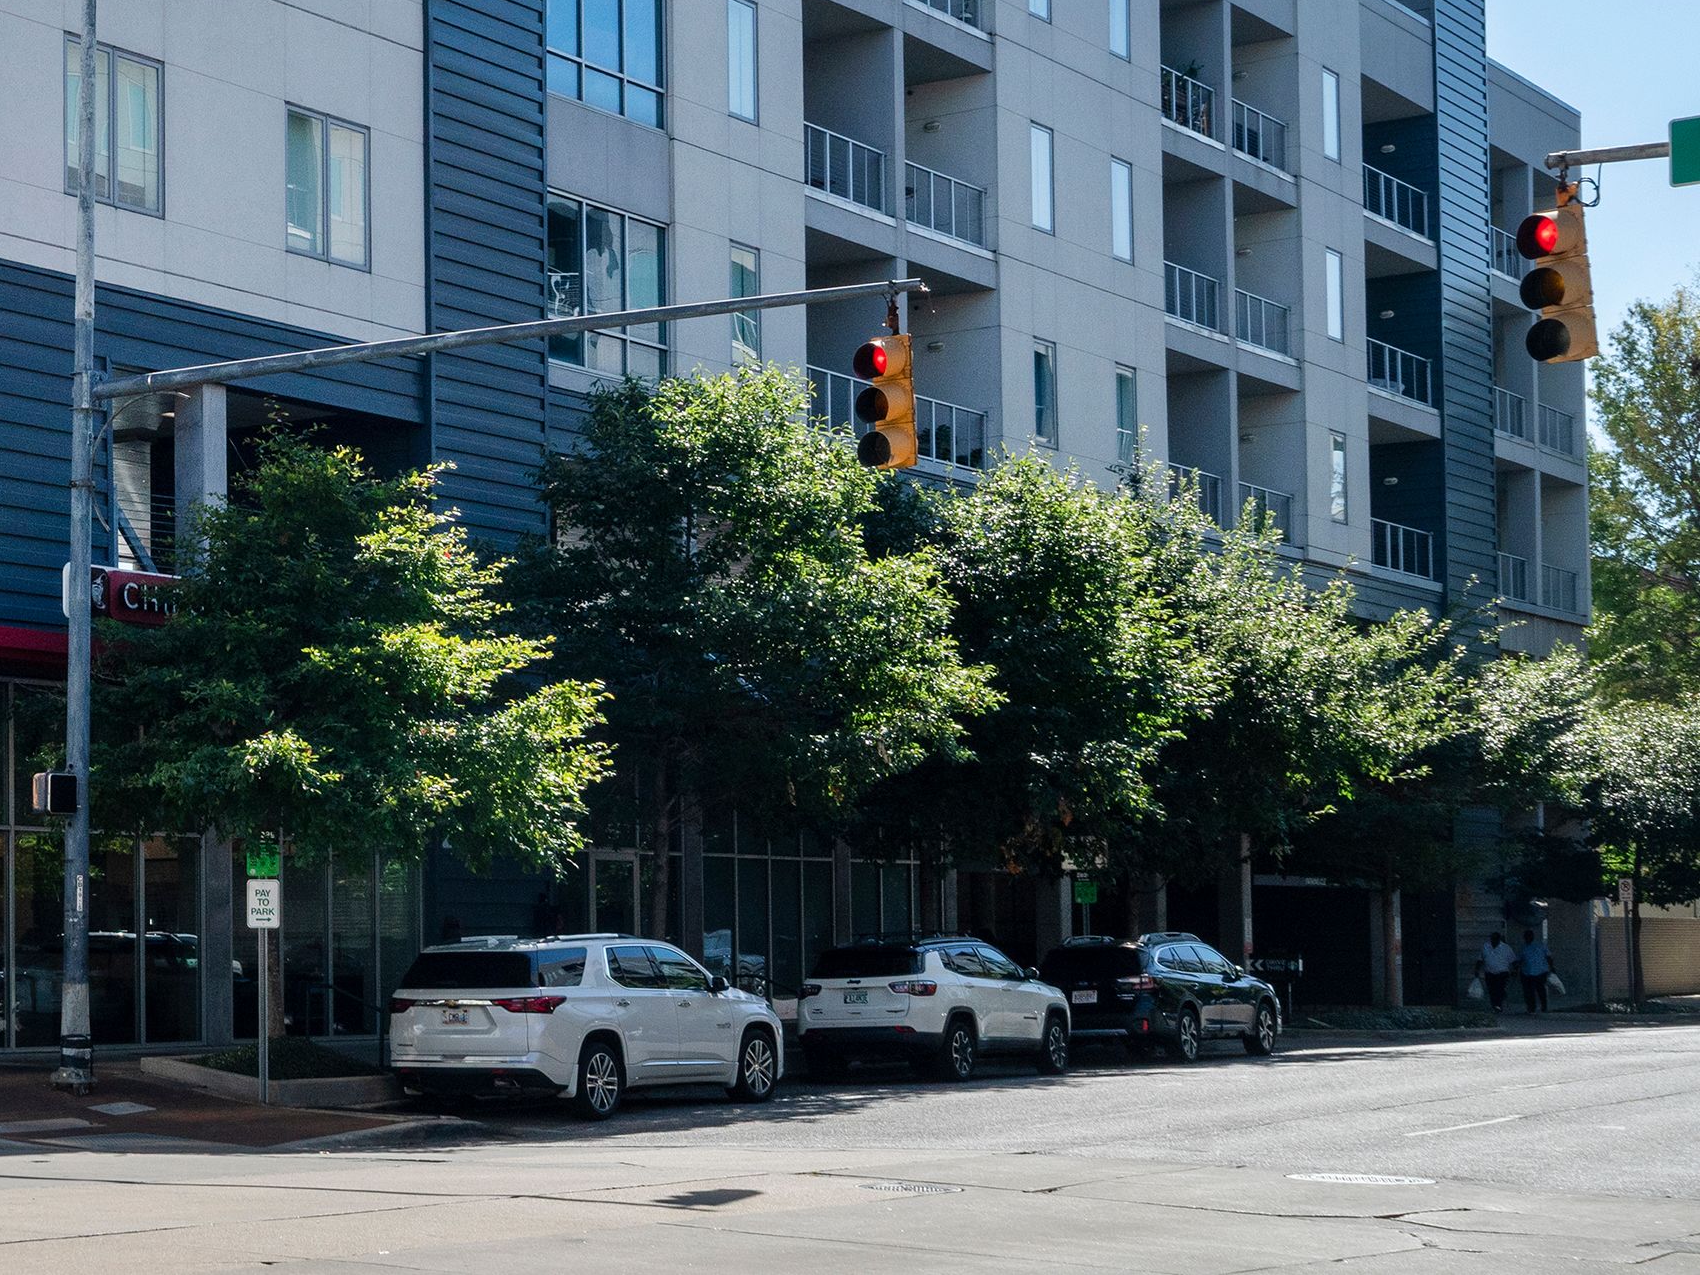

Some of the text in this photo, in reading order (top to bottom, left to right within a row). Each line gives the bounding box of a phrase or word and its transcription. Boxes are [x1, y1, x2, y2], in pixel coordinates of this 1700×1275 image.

[255, 889, 271, 897] PAY
[257, 898, 269, 906] TO
[251, 908, 275, 916] PARK
